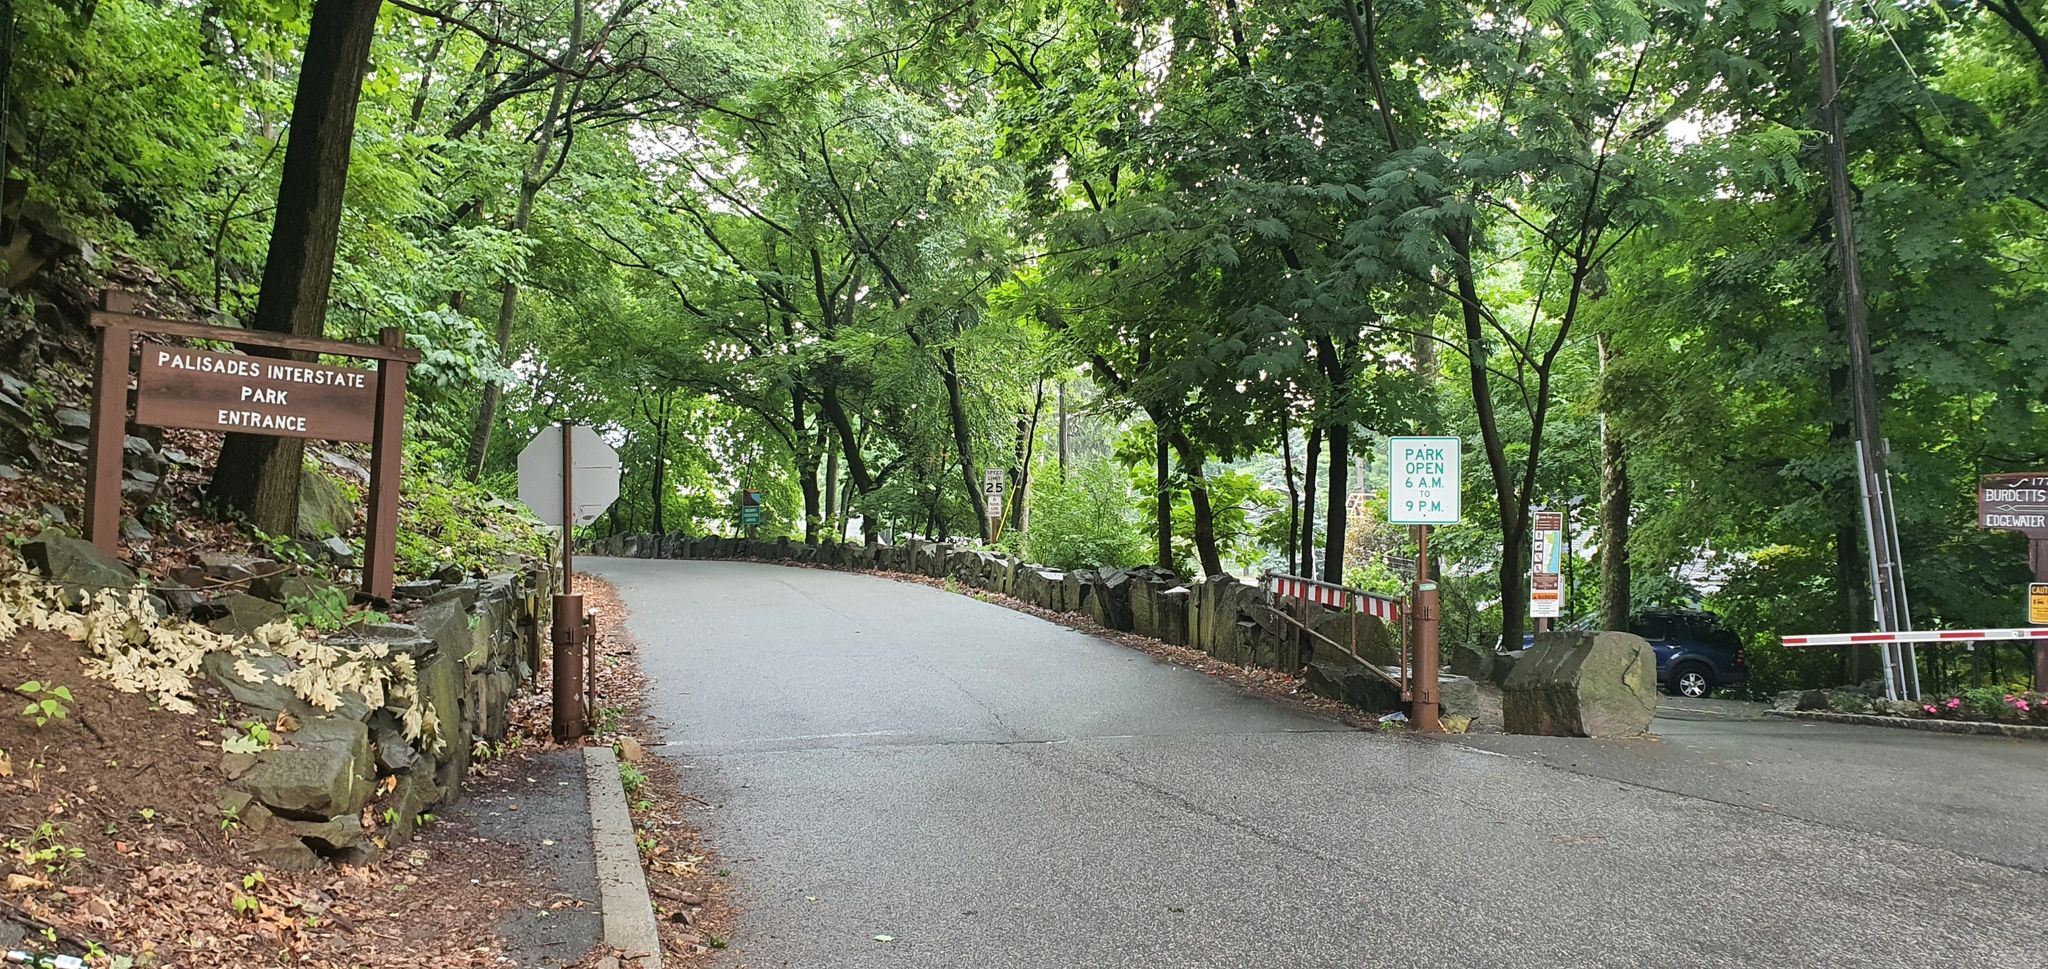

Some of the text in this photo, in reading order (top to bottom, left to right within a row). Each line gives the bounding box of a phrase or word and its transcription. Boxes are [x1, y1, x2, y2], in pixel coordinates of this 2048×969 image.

[158, 351, 365, 388] PALISADES INTERSTATE
[241, 386, 288, 405] PARK
[218, 409, 306, 431] ENTRANCE
[1405, 448, 1444, 461] PARK
[1405, 462, 1444, 475] OPEN
[986, 482, 1003, 492] 25
[1405, 477, 1444, 488] 6 A.M.
[1420, 490, 1430, 498] TO
[1985, 488, 2047, 502] BURDETTS
[1405, 500, 1444, 512] 9 P.M.
[1986, 514, 2045, 527] EDGEWATER
